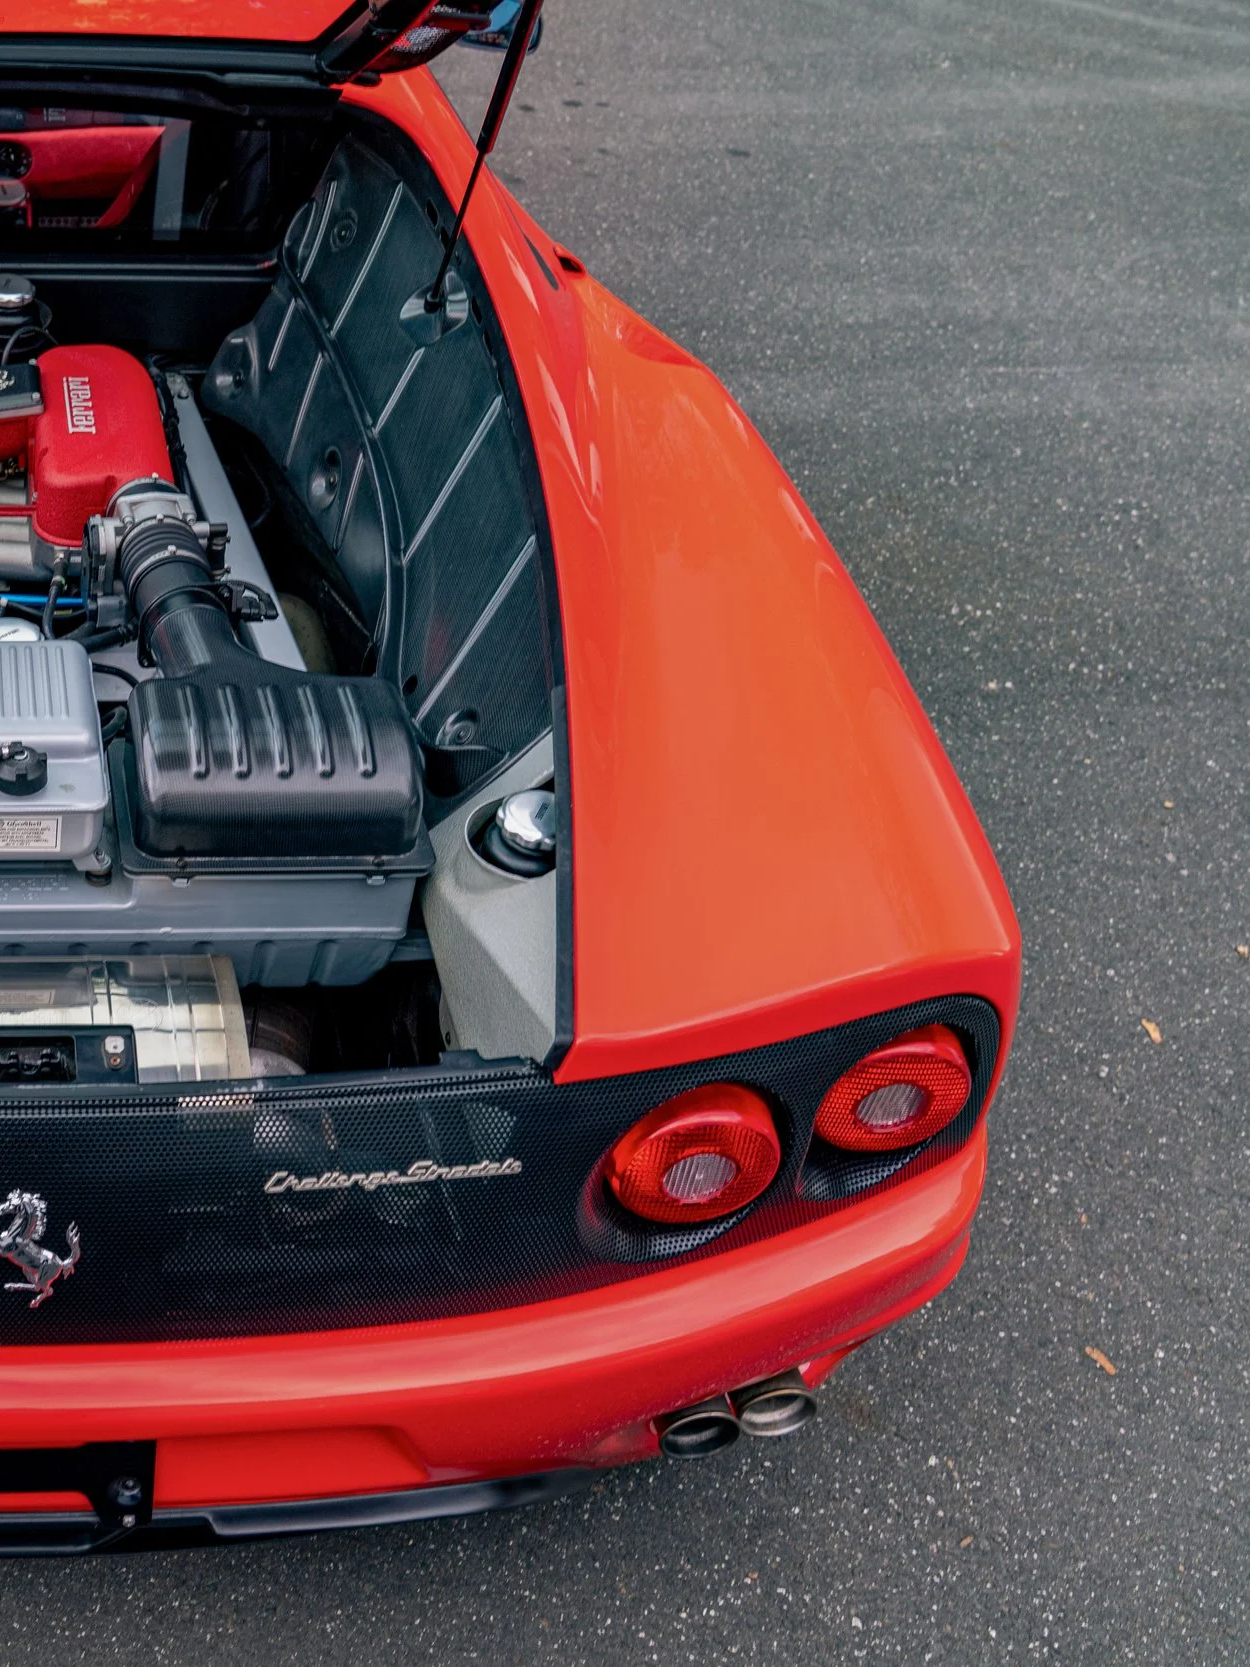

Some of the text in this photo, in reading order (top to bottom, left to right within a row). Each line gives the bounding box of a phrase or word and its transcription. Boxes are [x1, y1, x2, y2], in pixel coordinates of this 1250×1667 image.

[62, 376, 97, 434] Ferrari
[264, 1157, 523, 1193] Challenge Stradale
